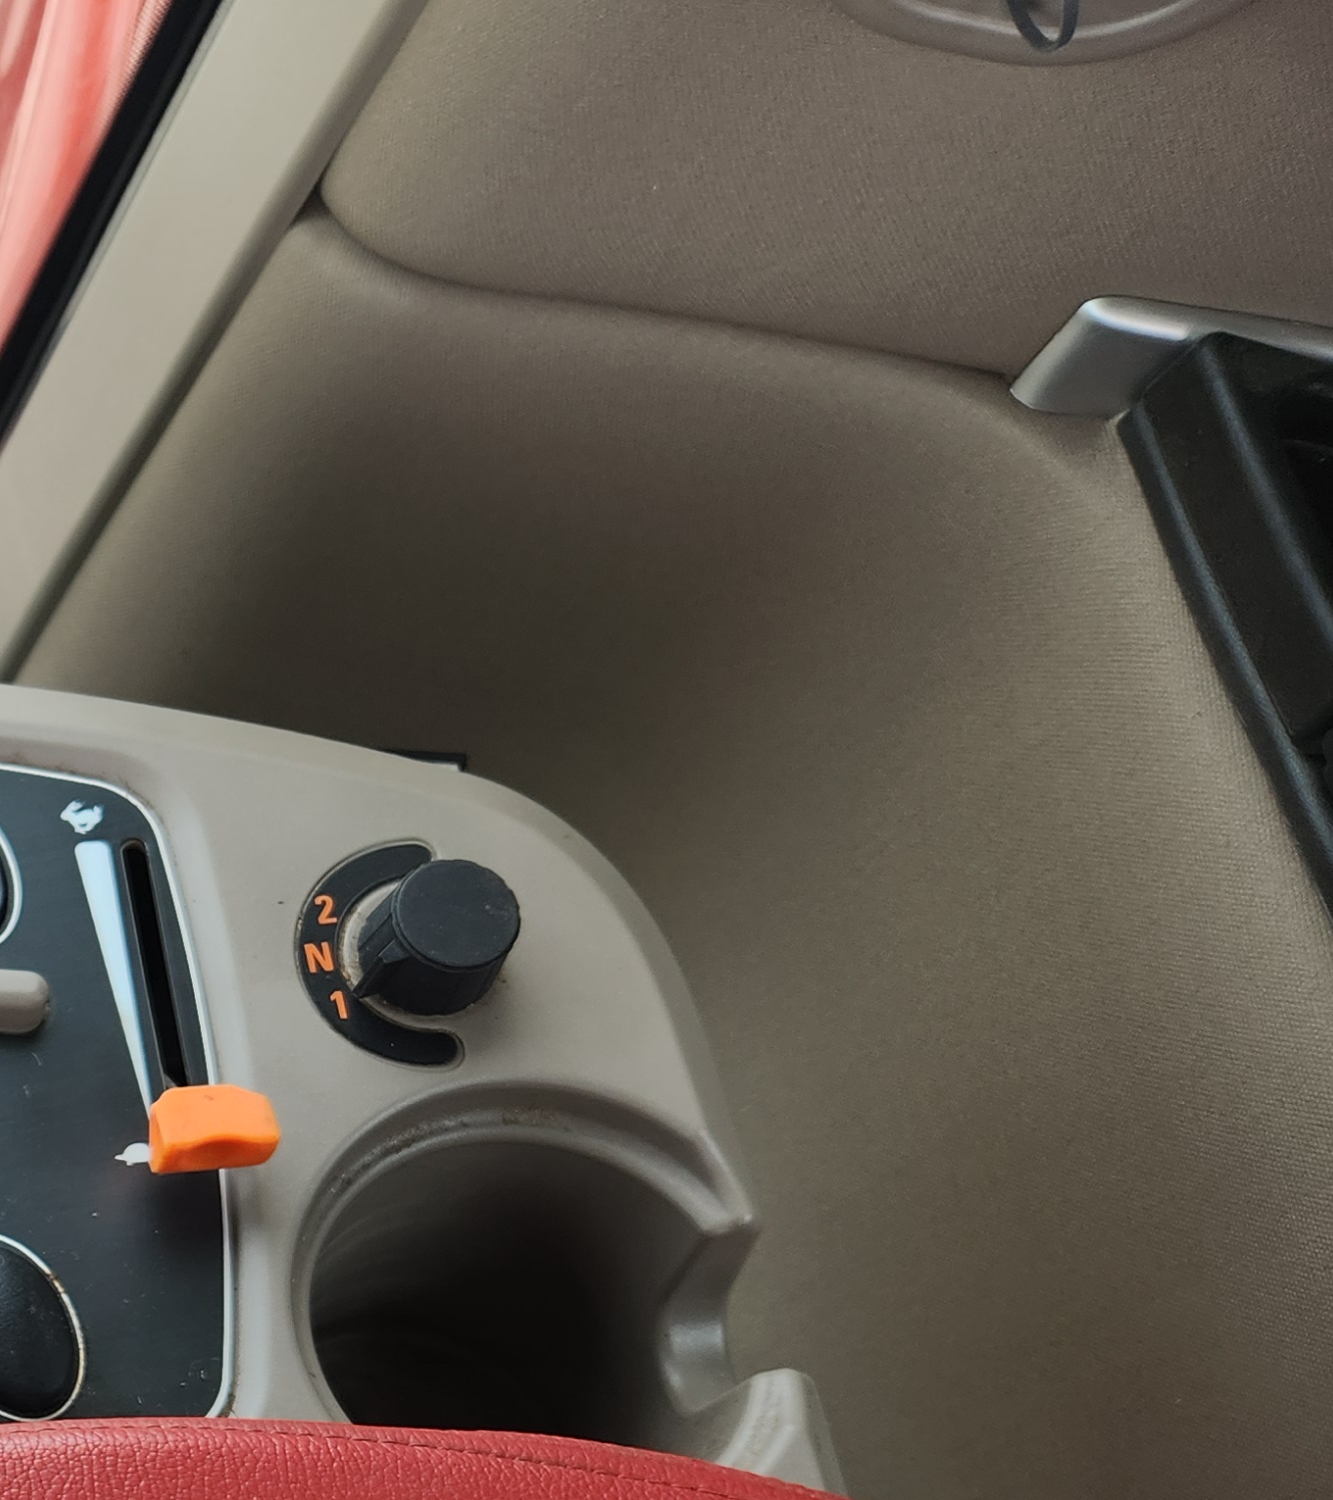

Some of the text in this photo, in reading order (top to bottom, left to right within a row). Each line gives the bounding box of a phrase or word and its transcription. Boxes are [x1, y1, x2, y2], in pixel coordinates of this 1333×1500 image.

[314, 895, 337, 925] 2
[304, 942, 334, 973] N
[330, 991, 348, 1020] 1
